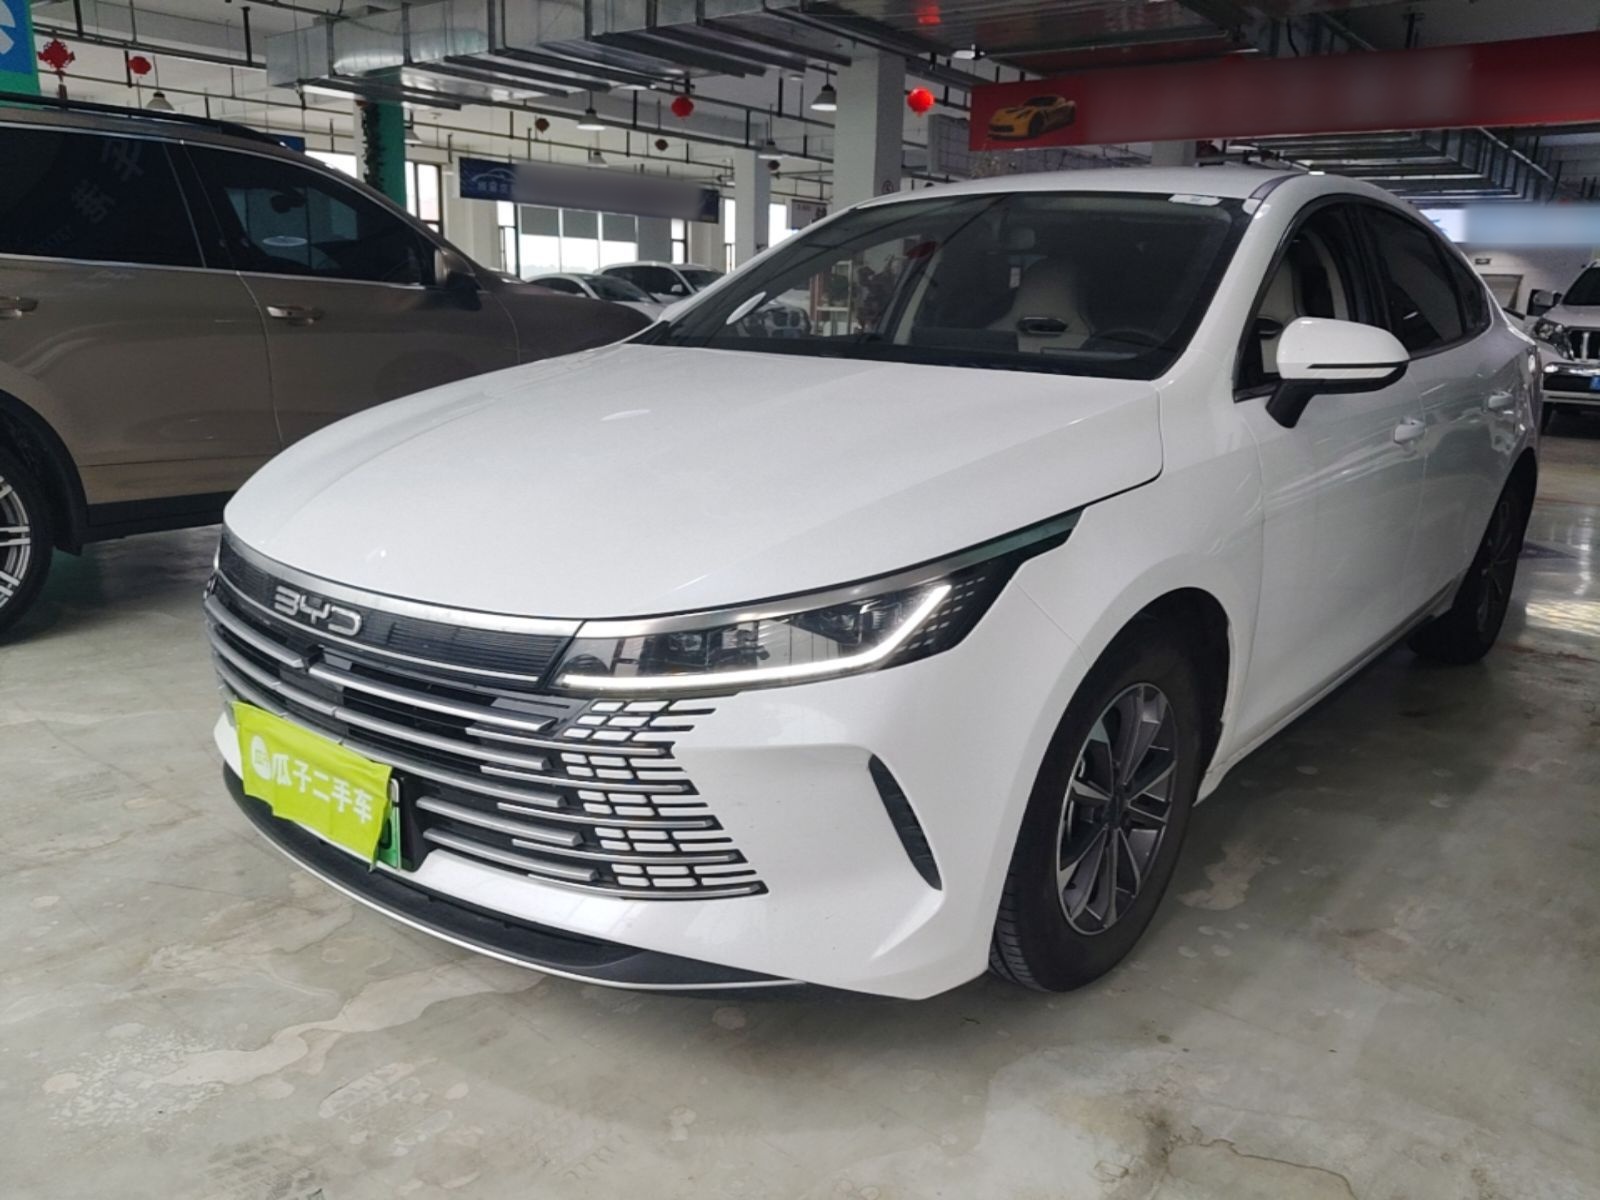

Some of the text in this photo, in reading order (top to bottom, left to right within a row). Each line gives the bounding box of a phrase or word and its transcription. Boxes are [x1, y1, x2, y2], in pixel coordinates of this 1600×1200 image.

[274, 585, 362, 636] BYD
[272, 753, 373, 824] 瓜子二手车
